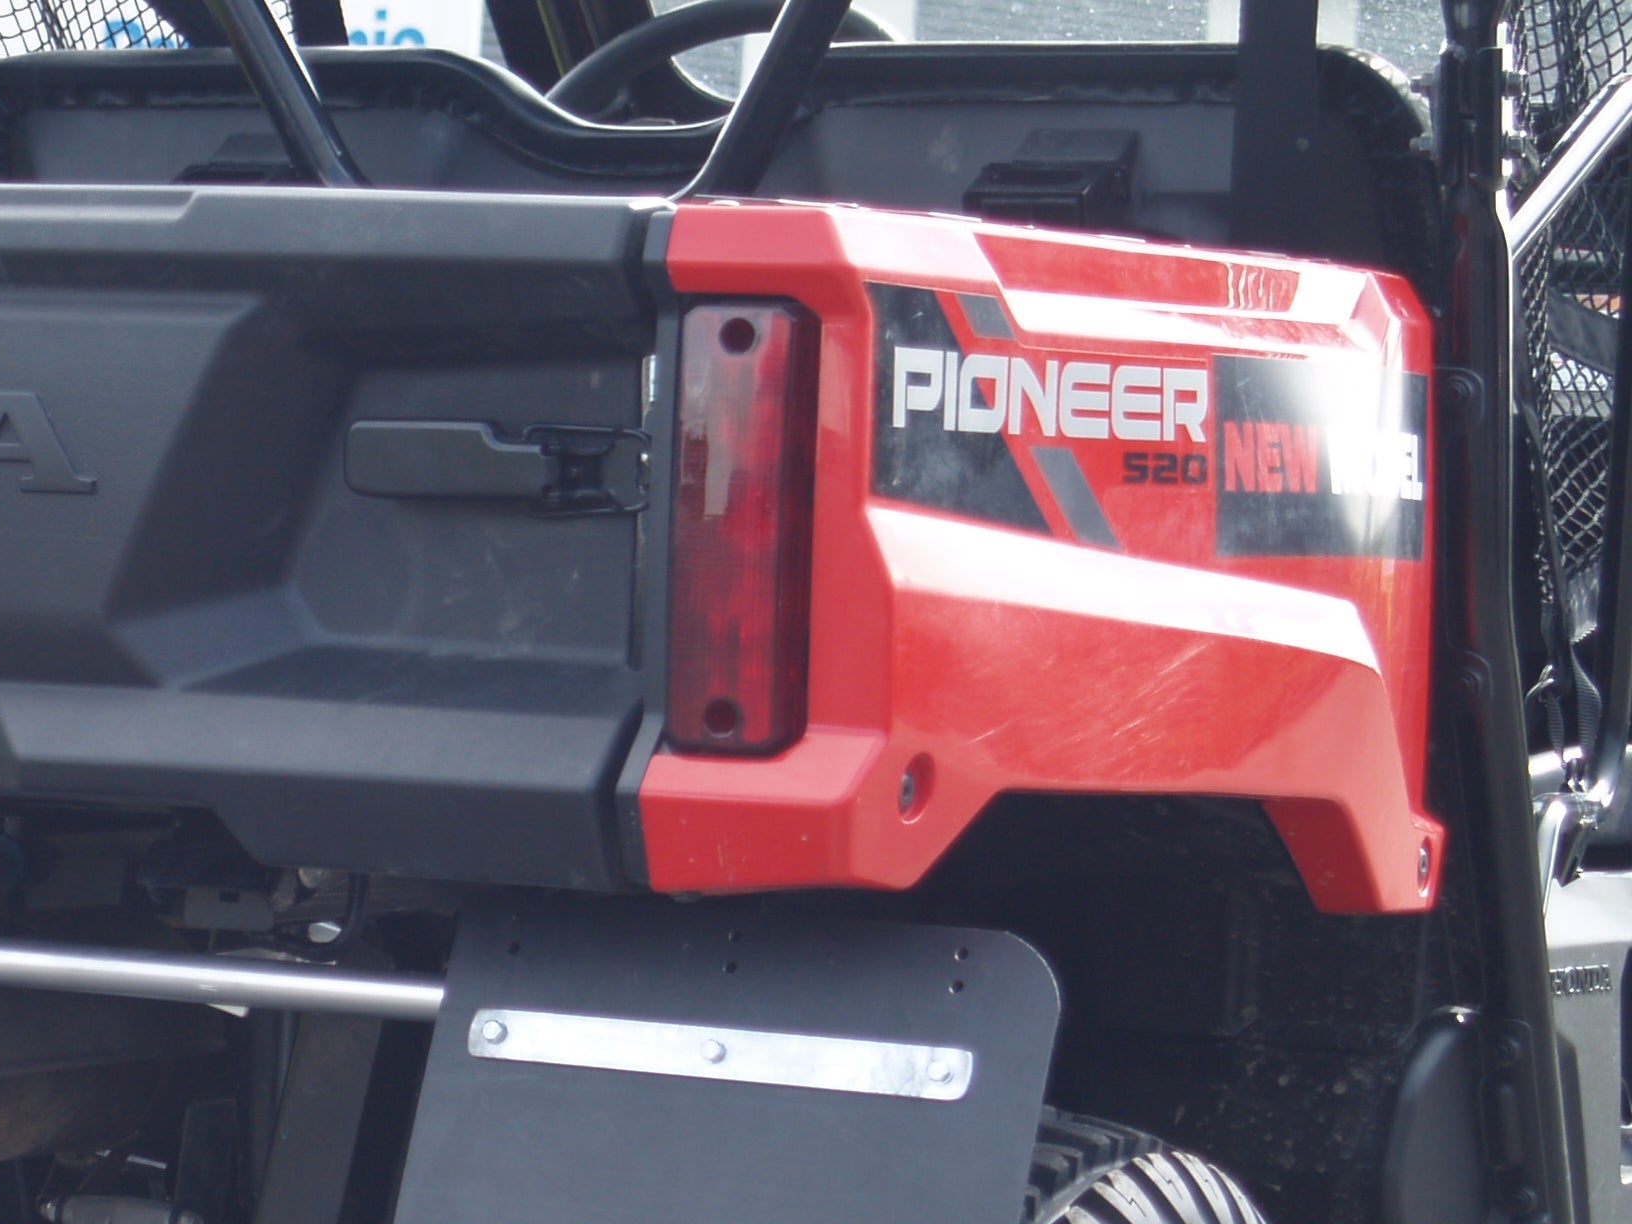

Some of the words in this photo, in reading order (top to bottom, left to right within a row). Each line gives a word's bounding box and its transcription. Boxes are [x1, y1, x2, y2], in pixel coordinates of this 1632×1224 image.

[892, 346, 1207, 442] PIONEER
[1122, 451, 1207, 486] 520
[1223, 420, 1318, 494] NEW
